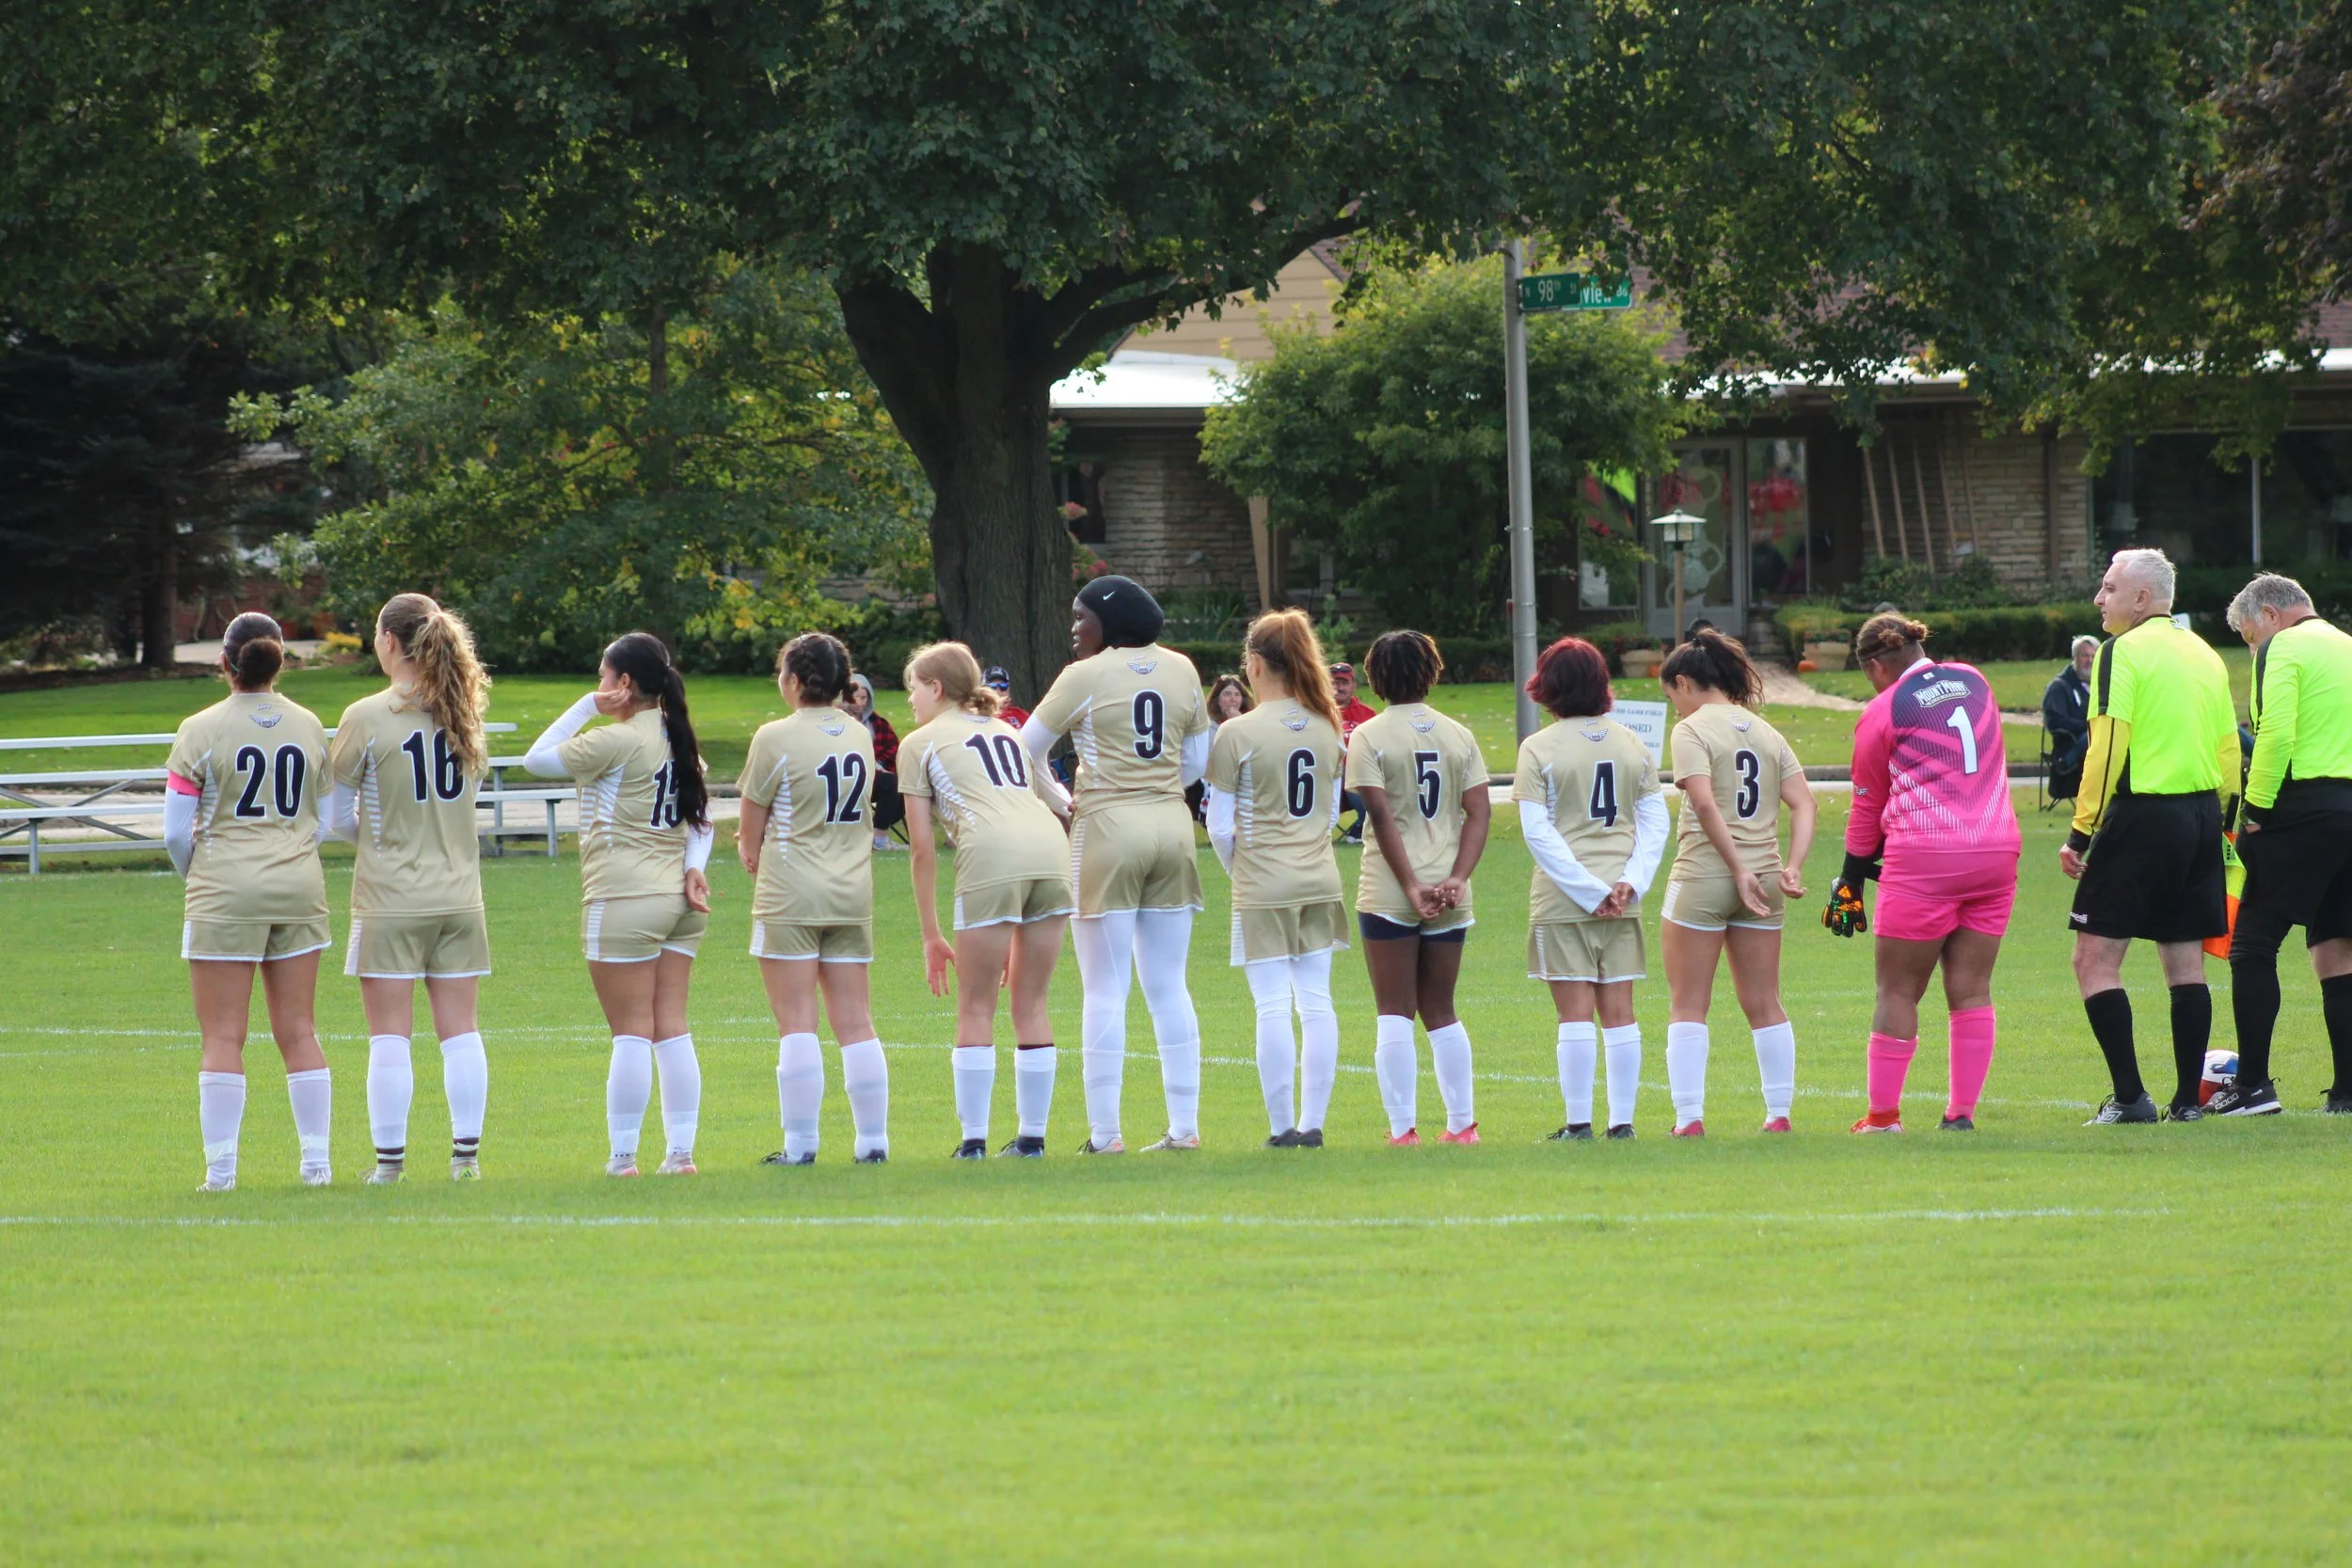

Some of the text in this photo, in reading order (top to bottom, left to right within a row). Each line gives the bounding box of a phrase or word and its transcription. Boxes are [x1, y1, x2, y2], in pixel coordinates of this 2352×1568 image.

[1133, 689, 1164, 760] 9
[1619, 722, 1652, 733] OSED
[1915, 684, 1944, 705] MOUNT
[1941, 681, 1967, 694] MARY
[401, 728, 465, 802] 16
[963, 733, 1029, 789] 10
[1947, 705, 1978, 774] 1
[235, 743, 307, 818] 20
[816, 751, 867, 824] 12
[1286, 747, 1317, 819] 6
[1413, 750, 1441, 821] 5
[1589, 760, 1618, 829] 4
[1735, 749, 1760, 819] 3
